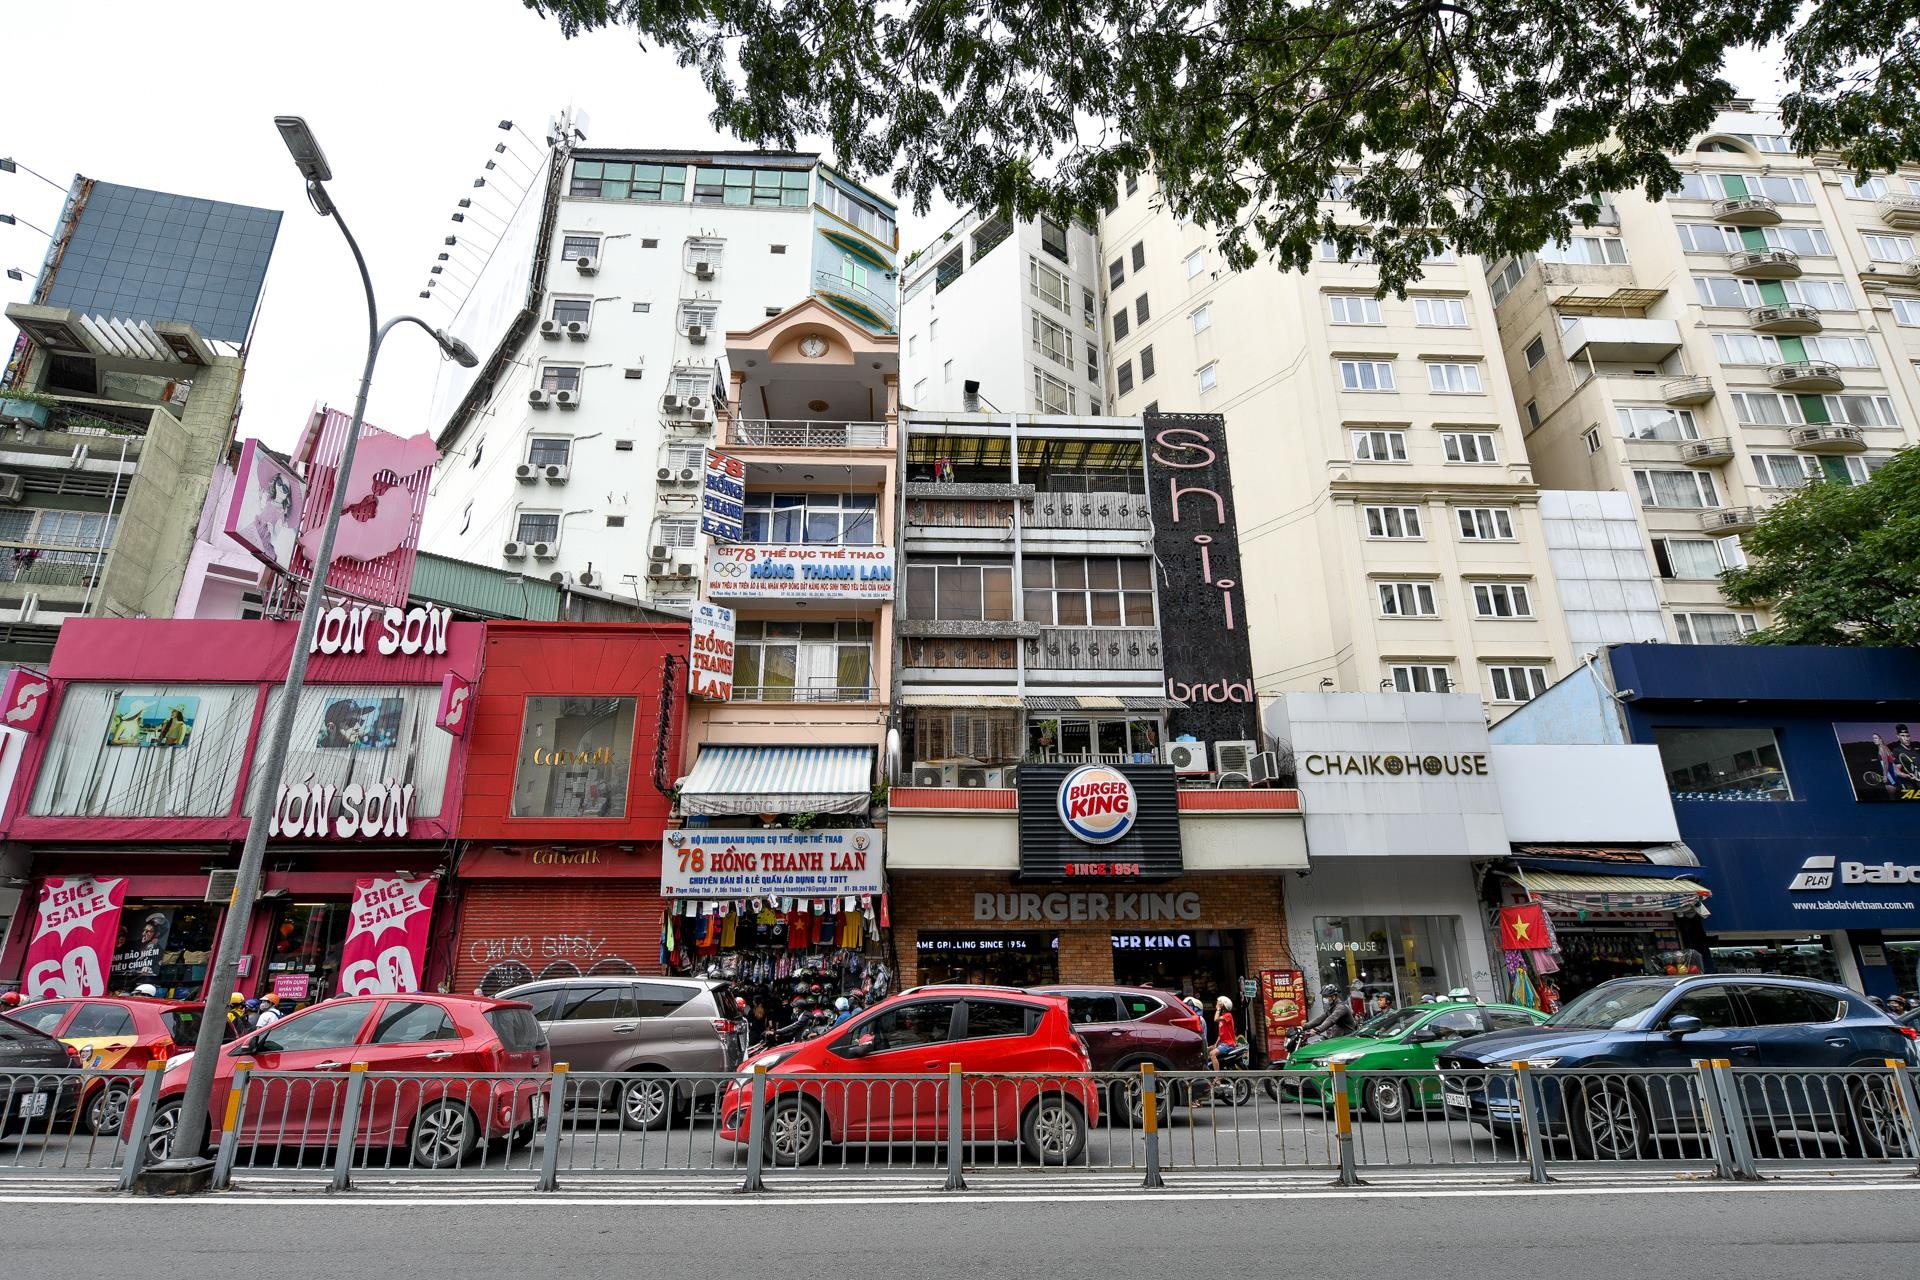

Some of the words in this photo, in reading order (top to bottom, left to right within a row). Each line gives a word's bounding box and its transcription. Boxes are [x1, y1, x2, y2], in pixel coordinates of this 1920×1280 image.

[708, 449, 744, 478] 78
[704, 494, 744, 521] THANH
[703, 516, 742, 542] LAN
[760, 547, 787, 558] THỂ
[789, 550, 817, 560] DỤC
[819, 548, 846, 559] THỂ
[848, 551, 885, 559] THAO
[801, 564, 855, 580] THANH
[860, 565, 892, 581] LAN
[718, 608, 731, 621] 78
[378, 601, 452, 655] SƠN
[693, 652, 733, 675] THANH
[691, 669, 732, 700] LAN
[1168, 677, 1253, 703] bridal
[533, 747, 615, 767] Catwalk
[1305, 754, 1489, 776] CHAIKOHOUSE
[1070, 782, 1127, 800] BURGER
[335, 777, 415, 838] SƠN
[1070, 795, 1129, 819] KING
[702, 836, 719, 844] KINH
[721, 836, 744, 844] DOANH
[825, 835, 843, 844] THAO
[532, 850, 601, 865] Catwalk
[677, 847, 705, 873] 78
[710, 844, 757, 872] HỒNG
[760, 852, 823, 872] THANH
[830, 852, 866, 872] LAN
[689, 875, 718, 885] CHUYÊN
[720, 875, 735, 884] BÁN
[783, 875, 794, 884] ÁO
[817, 876, 827, 885] CỤ
[829, 876, 848, 884] TDTT
[1064, 863, 1107, 876] SINCE
[1110, 863, 1140, 876] 1954
[1805, 875, 1829, 886] PLAY
[53, 881, 94, 907] BIG
[364, 882, 404, 907] BIG
[665, 886, 674, 894] 78
[46, 894, 106, 928] SALE
[359, 895, 417, 928] SALE
[974, 893, 1110, 921] BURGER
[1114, 892, 1200, 921] KING
[1792, 901, 1915, 910] www.babolatvietnam.com.vn
[979, 941, 1004, 949] SINCE
[1274, 977, 1290, 985] FREE
